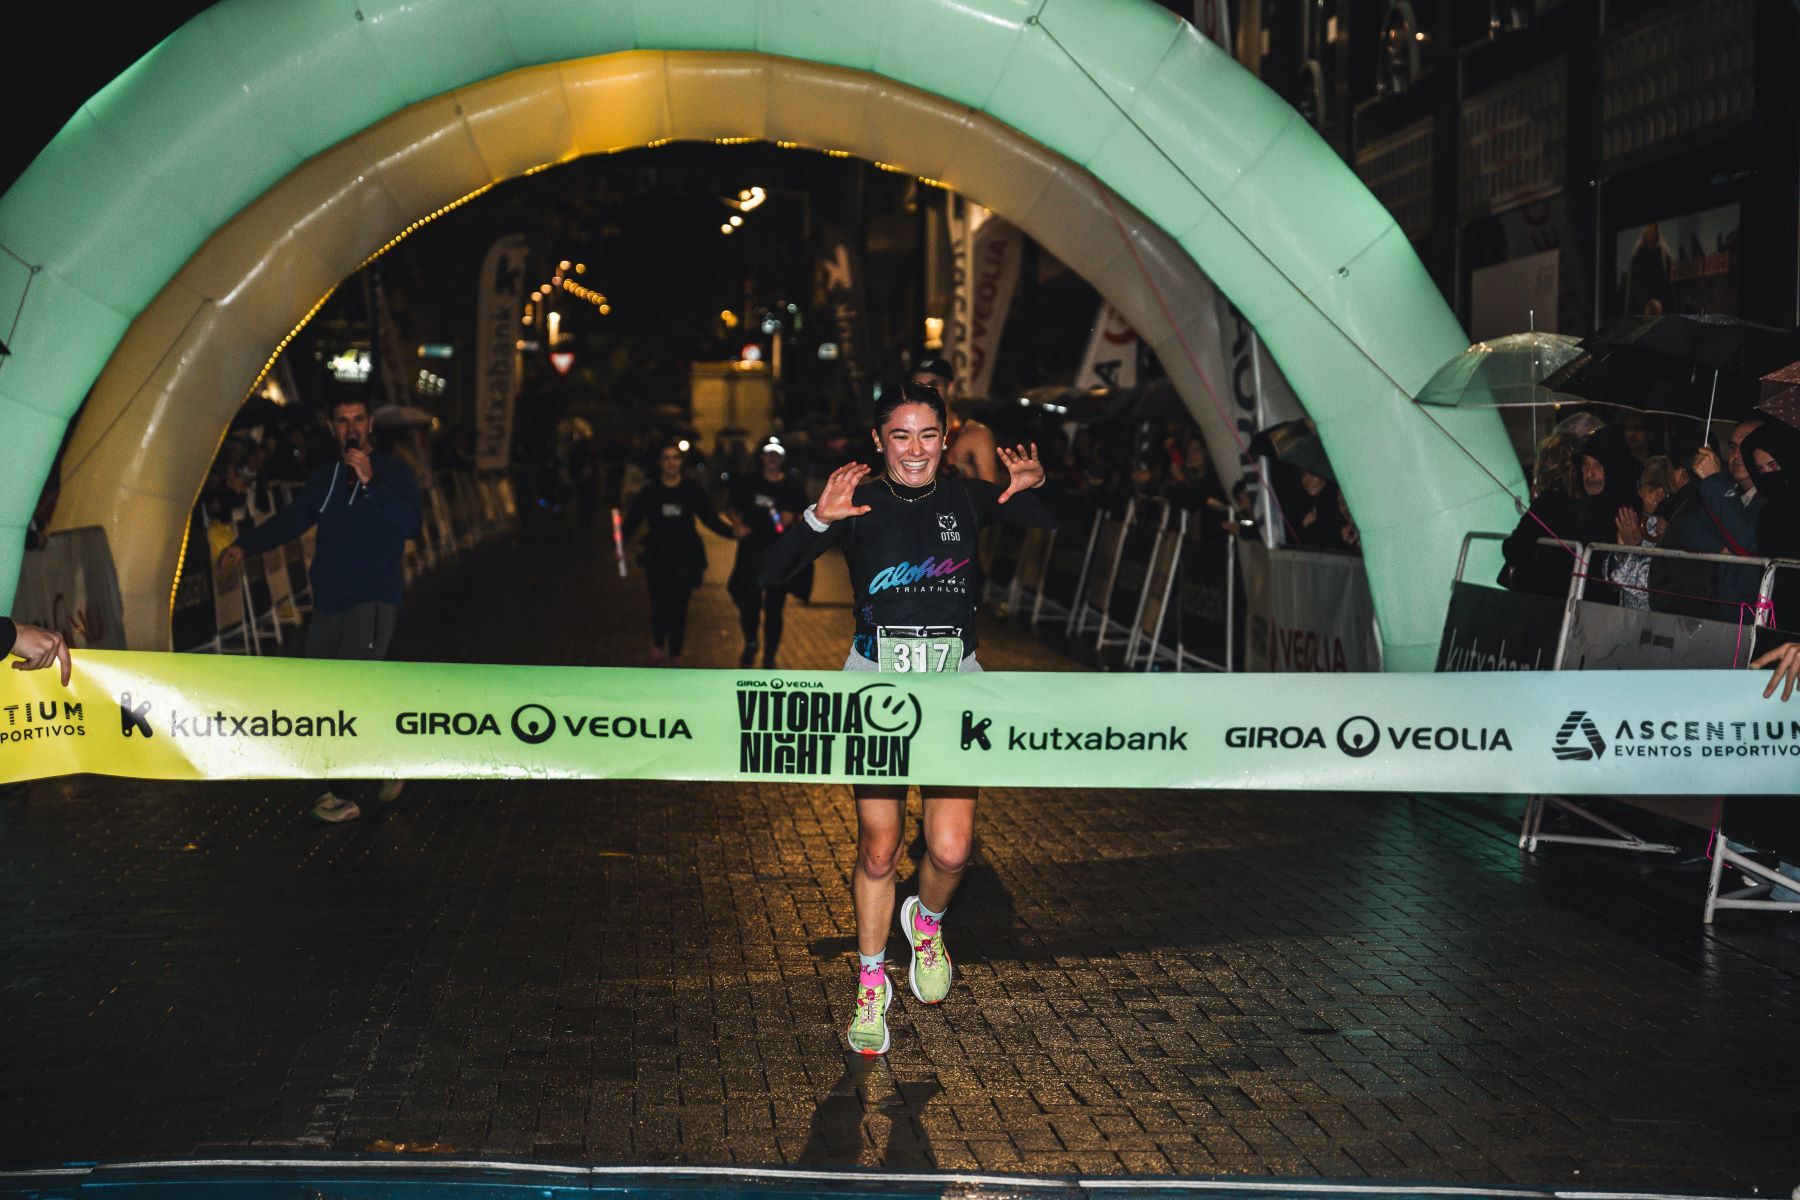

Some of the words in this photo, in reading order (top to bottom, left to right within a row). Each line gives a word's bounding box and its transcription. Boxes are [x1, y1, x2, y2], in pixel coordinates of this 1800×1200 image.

[972, 239, 1008, 338] VEOLIA
[941, 532, 960, 542] OTSO
[895, 586, 966, 594] TRIATHLON
[893, 643, 950, 672] 317
[737, 680, 768, 688] GIROA
[785, 681, 824, 689] VEOLIA
[171, 709, 358, 737] kutxabank
[737, 690, 863, 734] VITORIA
[396, 712, 501, 735] GIROA
[563, 716, 693, 740] VEOLIA
[1008, 725, 1188, 751] kutxabank
[1225, 726, 1326, 749] GIROA
[1387, 727, 1513, 752] VEOLIA
[740, 732, 836, 775] NIGHT
[845, 735, 911, 777] RUN
[1614, 745, 1692, 758] EVENTOS
